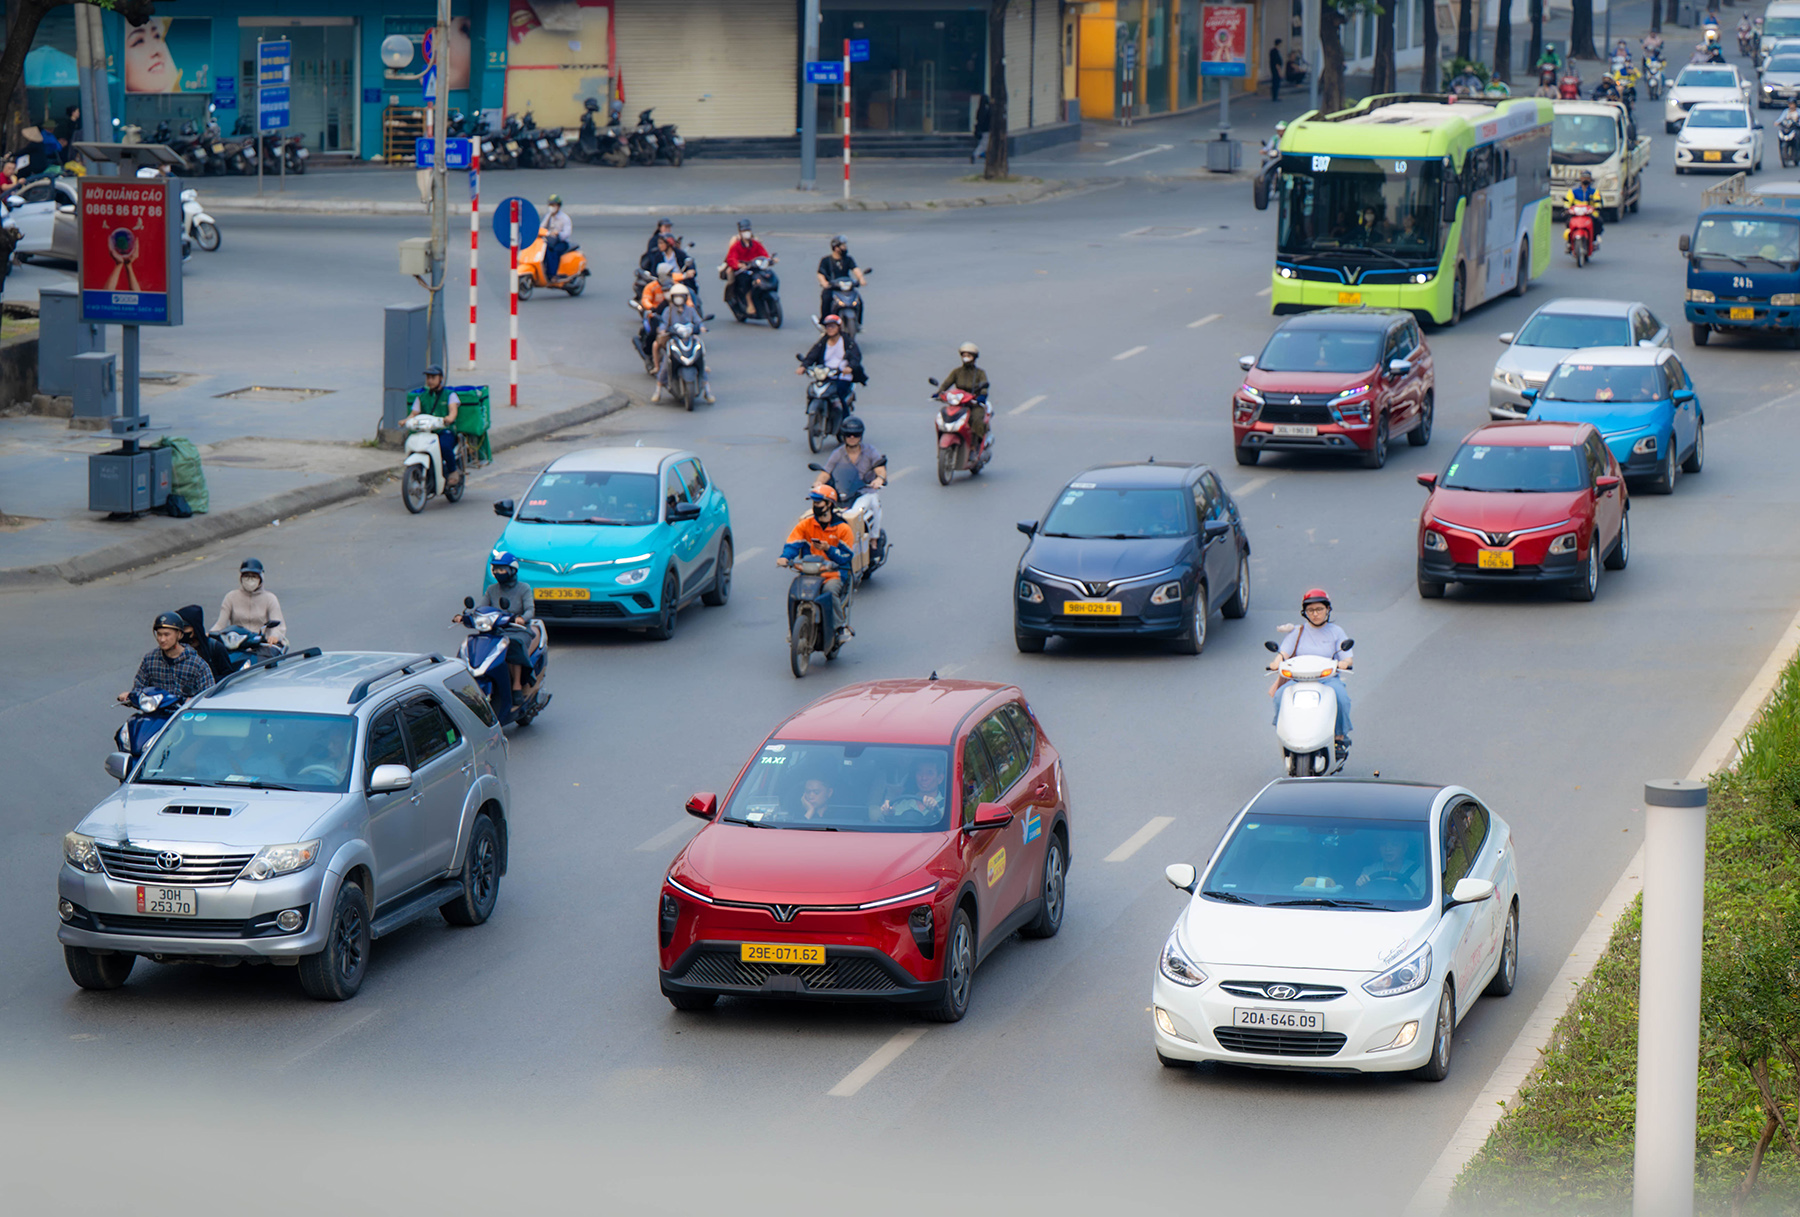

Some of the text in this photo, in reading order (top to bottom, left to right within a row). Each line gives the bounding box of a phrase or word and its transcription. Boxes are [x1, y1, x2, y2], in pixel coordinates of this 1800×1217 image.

[1312, 156, 1331, 172] E07
[86, 187, 163, 202] MỜI QUẢNG CÁO
[86, 203, 163, 217] 0865 86 87 86
[760, 756, 787, 765] TAXI
[159, 888, 181, 901] 30H
[150, 900, 191, 914] 253.70
[748, 946, 818, 961] 29E-071.62
[1241, 1011, 1316, 1028] 20A-646.09
